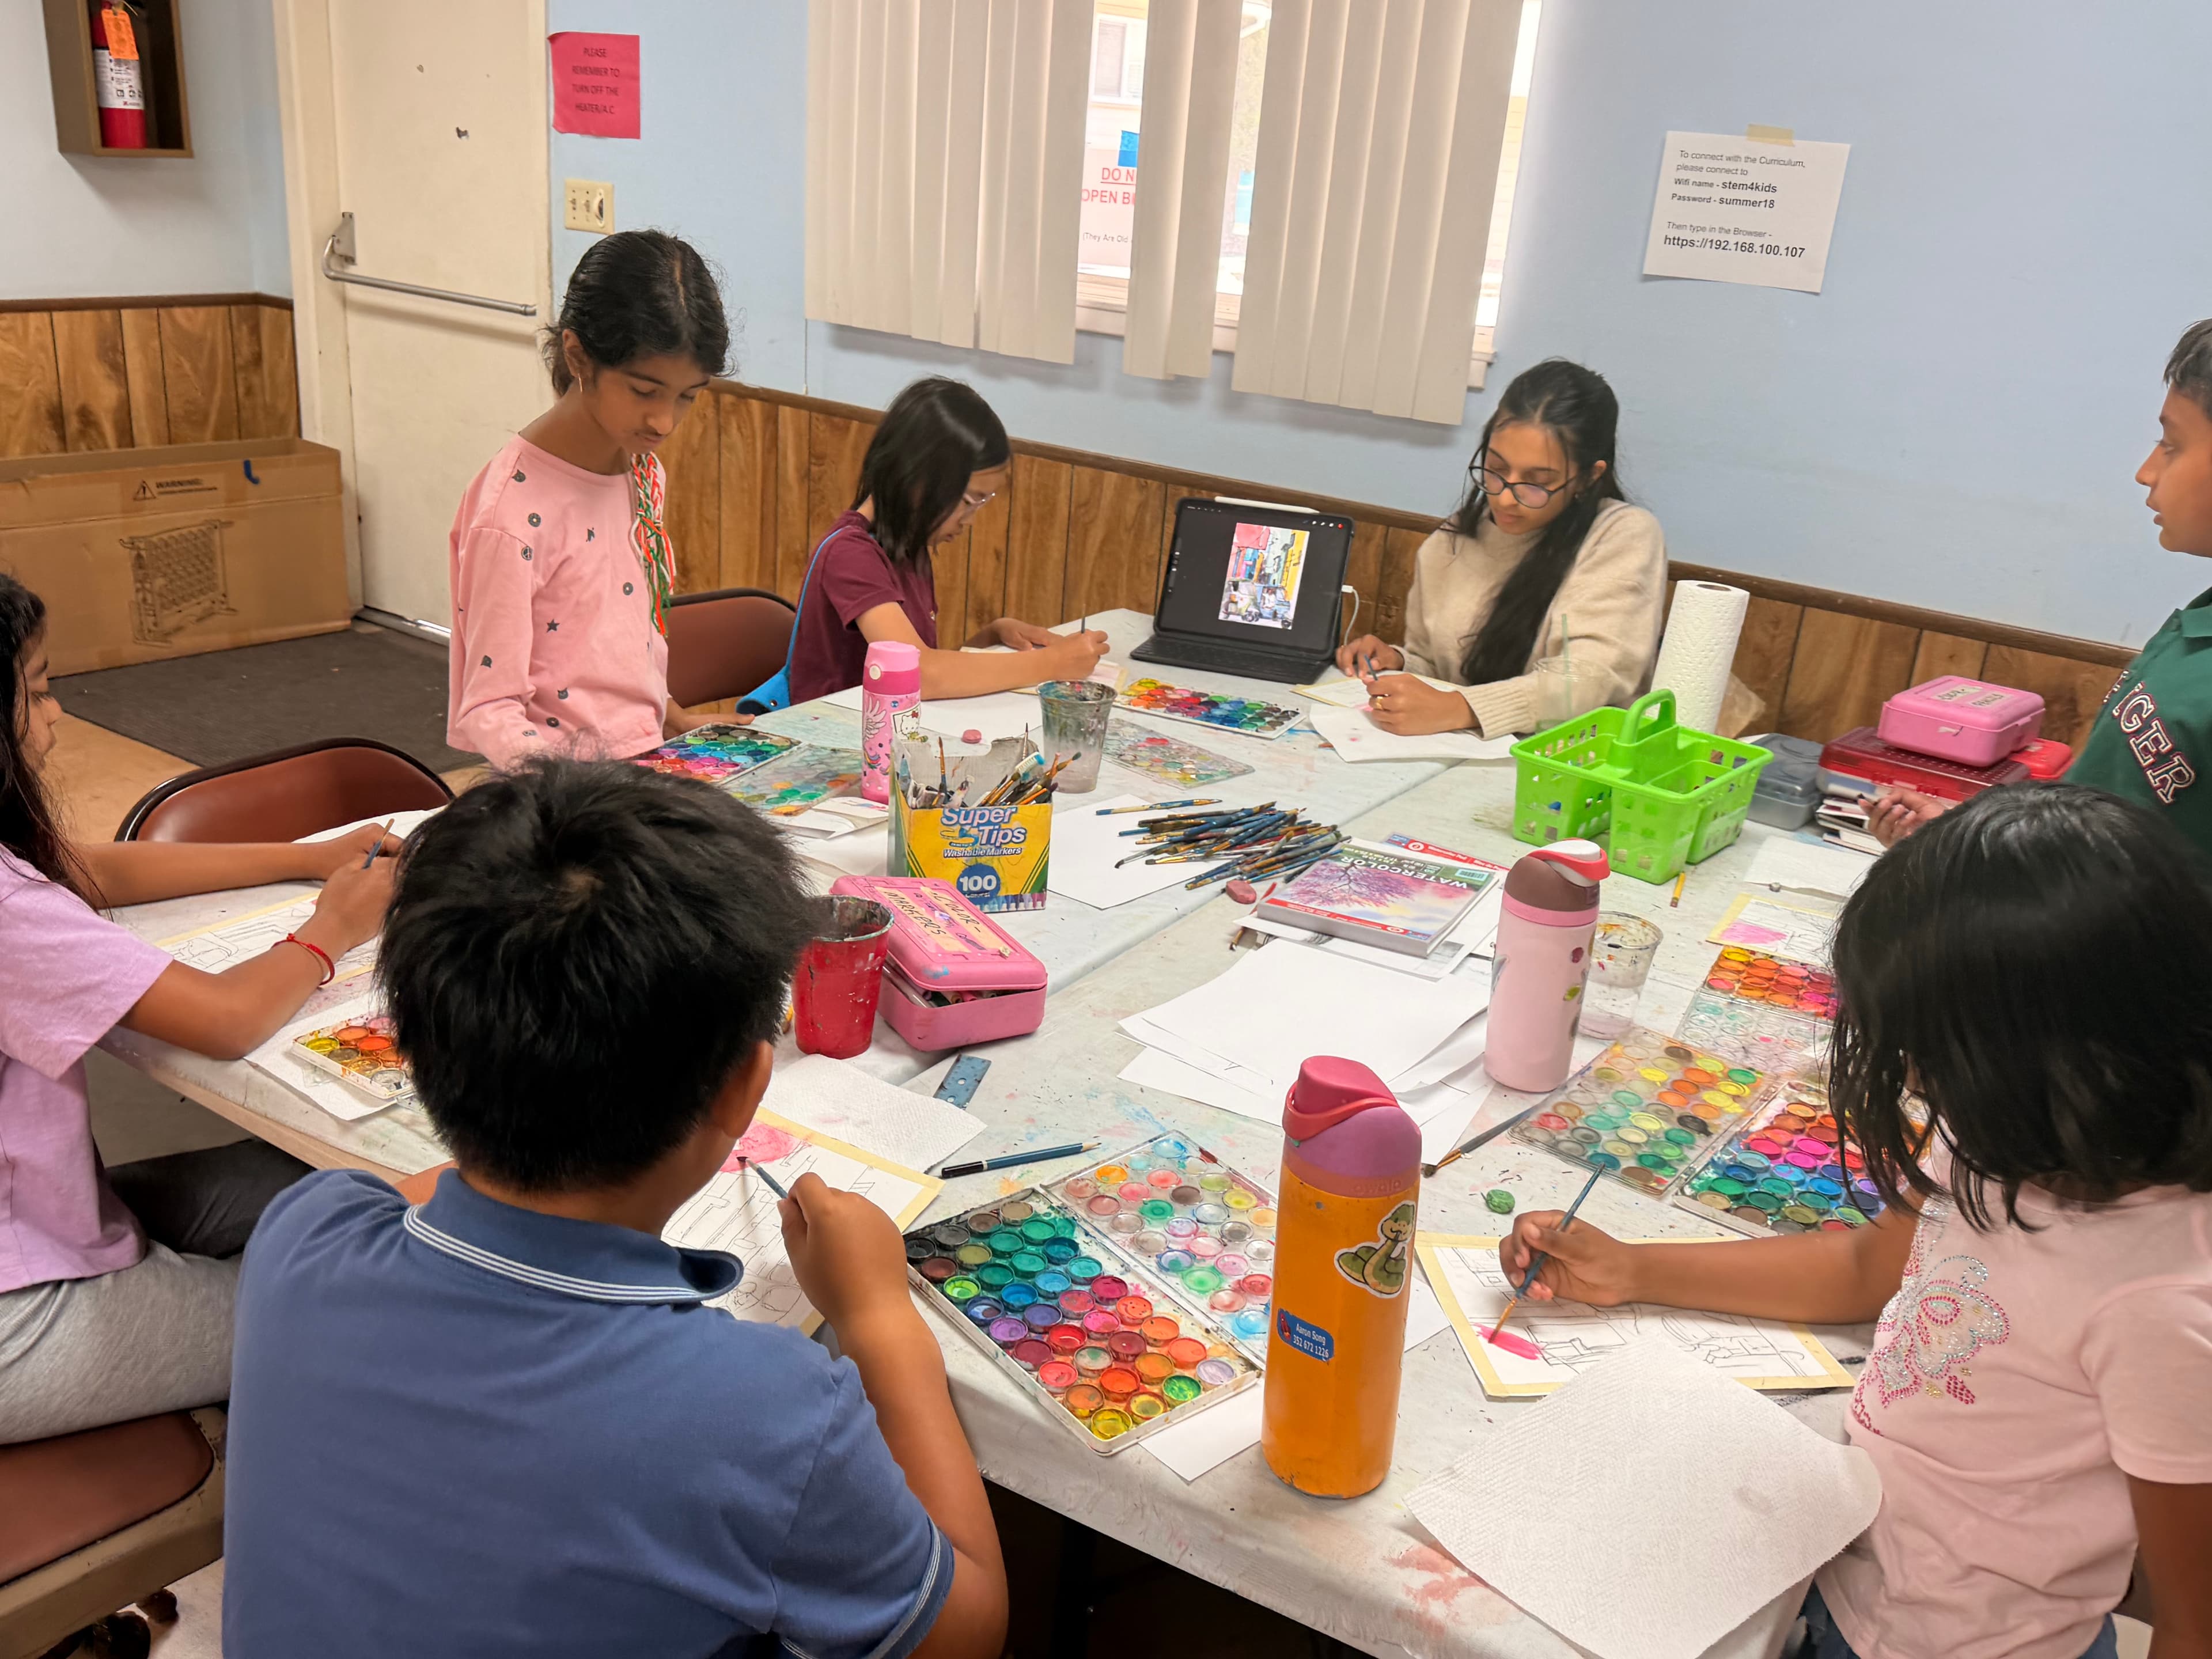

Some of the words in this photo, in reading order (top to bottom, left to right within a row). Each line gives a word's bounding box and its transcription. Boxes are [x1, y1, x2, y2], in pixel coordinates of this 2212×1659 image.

[584, 47, 607, 58] PLEASE
[572, 66, 608, 76] REMEMBER
[611, 68, 620, 77] TO
[572, 84, 589, 93] TURN
[591, 86, 604, 94] OFF
[605, 87, 619, 96] THE
[1680, 150, 1688, 158] To
[1691, 152, 1723, 161] connect
[1726, 154, 1742, 162] with
[1744, 155, 1757, 164] the
[1759, 156, 1805, 168] Curriculum,
[1102, 168, 1121, 181] DO
[1676, 163, 1703, 173] please
[1706, 165, 1738, 175] connect
[1740, 168, 1748, 176] to
[1674, 177, 1690, 186] Wifi
[1692, 180, 1714, 188] name
[1721, 181, 1777, 193] stem4kids
[1082, 189, 1117, 204] OPEN
[1672, 193, 1711, 203] Password
[1719, 197, 1775, 209] summer18
[1667, 221, 1687, 230] Then
[1689, 224, 1706, 233] type
[1709, 225, 1716, 233] in
[1718, 225, 1730, 234] the
[1733, 227, 1767, 237] Browser
[1103, 234, 1114, 242] Are
[1664, 234, 1805, 258] https://192.168.100.107
[941, 806, 1017, 826] Super
[979, 825, 1027, 846] Tips
[943, 848, 987, 858] Washable
[987, 847, 1022, 857] Markers
[1340, 856, 1468, 889] WATERCOLOR
[959, 874, 997, 892] 100
[884, 892, 946, 936] MARKERS
[1296, 1323, 1311, 1338] Aaron
[1312, 1331, 1326, 1346] Song
[1304, 1340, 1314, 1353] 672
